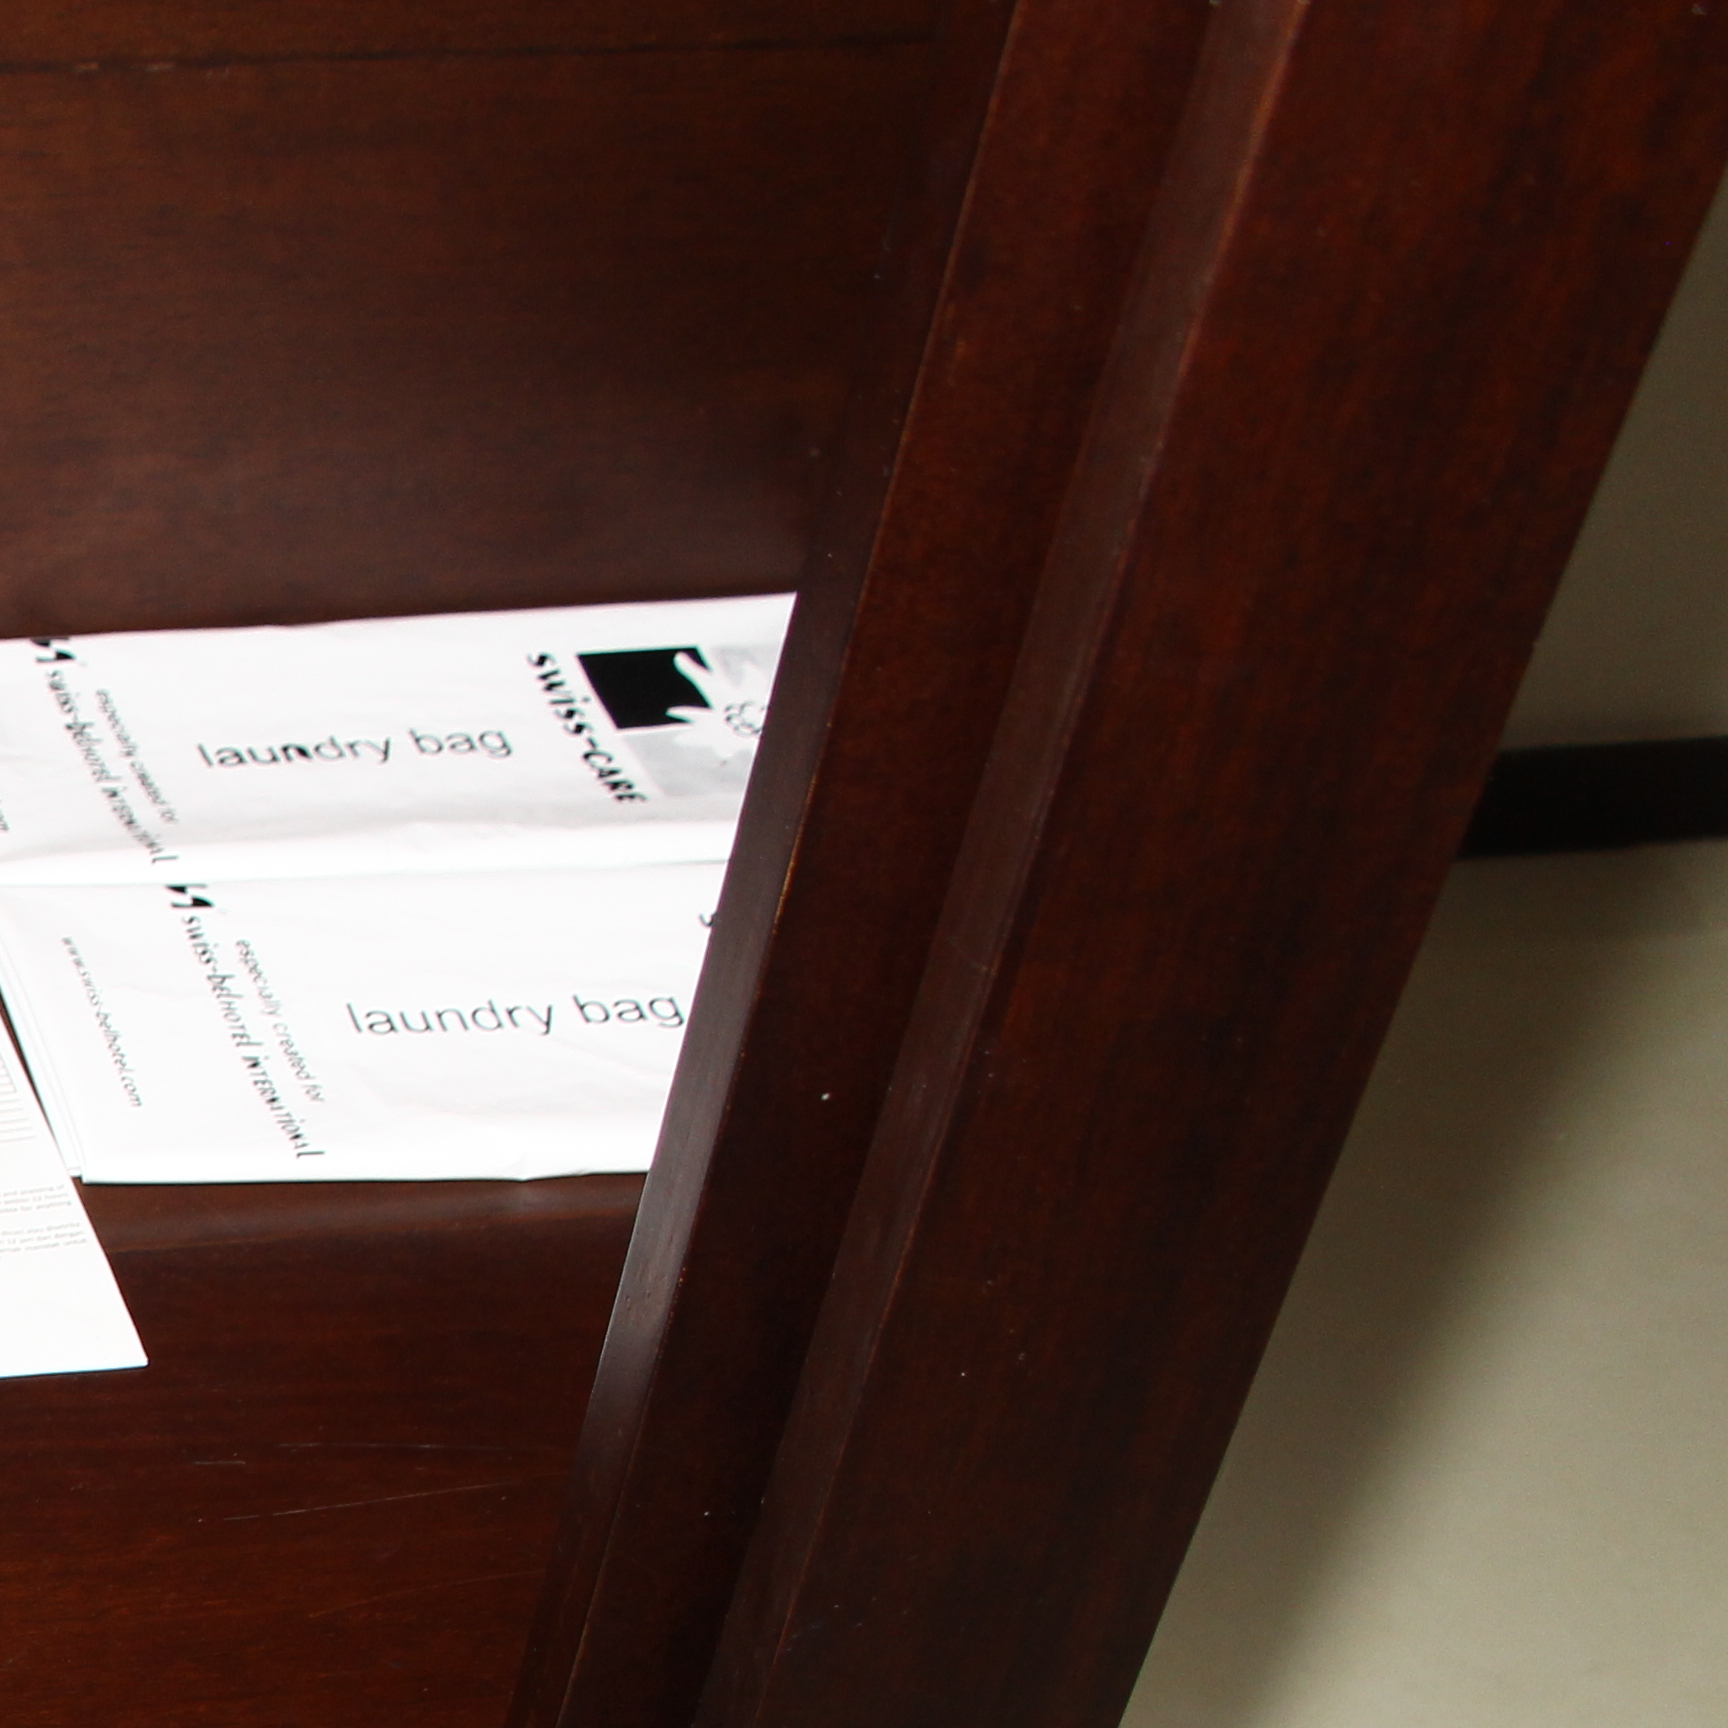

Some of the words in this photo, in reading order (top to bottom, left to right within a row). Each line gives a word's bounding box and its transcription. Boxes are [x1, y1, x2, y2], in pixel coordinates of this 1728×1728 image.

[197, 734, 392, 768] laundry
[409, 727, 513, 760] bag
[345, 999, 554, 1036] laundry
[572, 992, 686, 1029] bag
[272, 1021, 316, 1083] created
